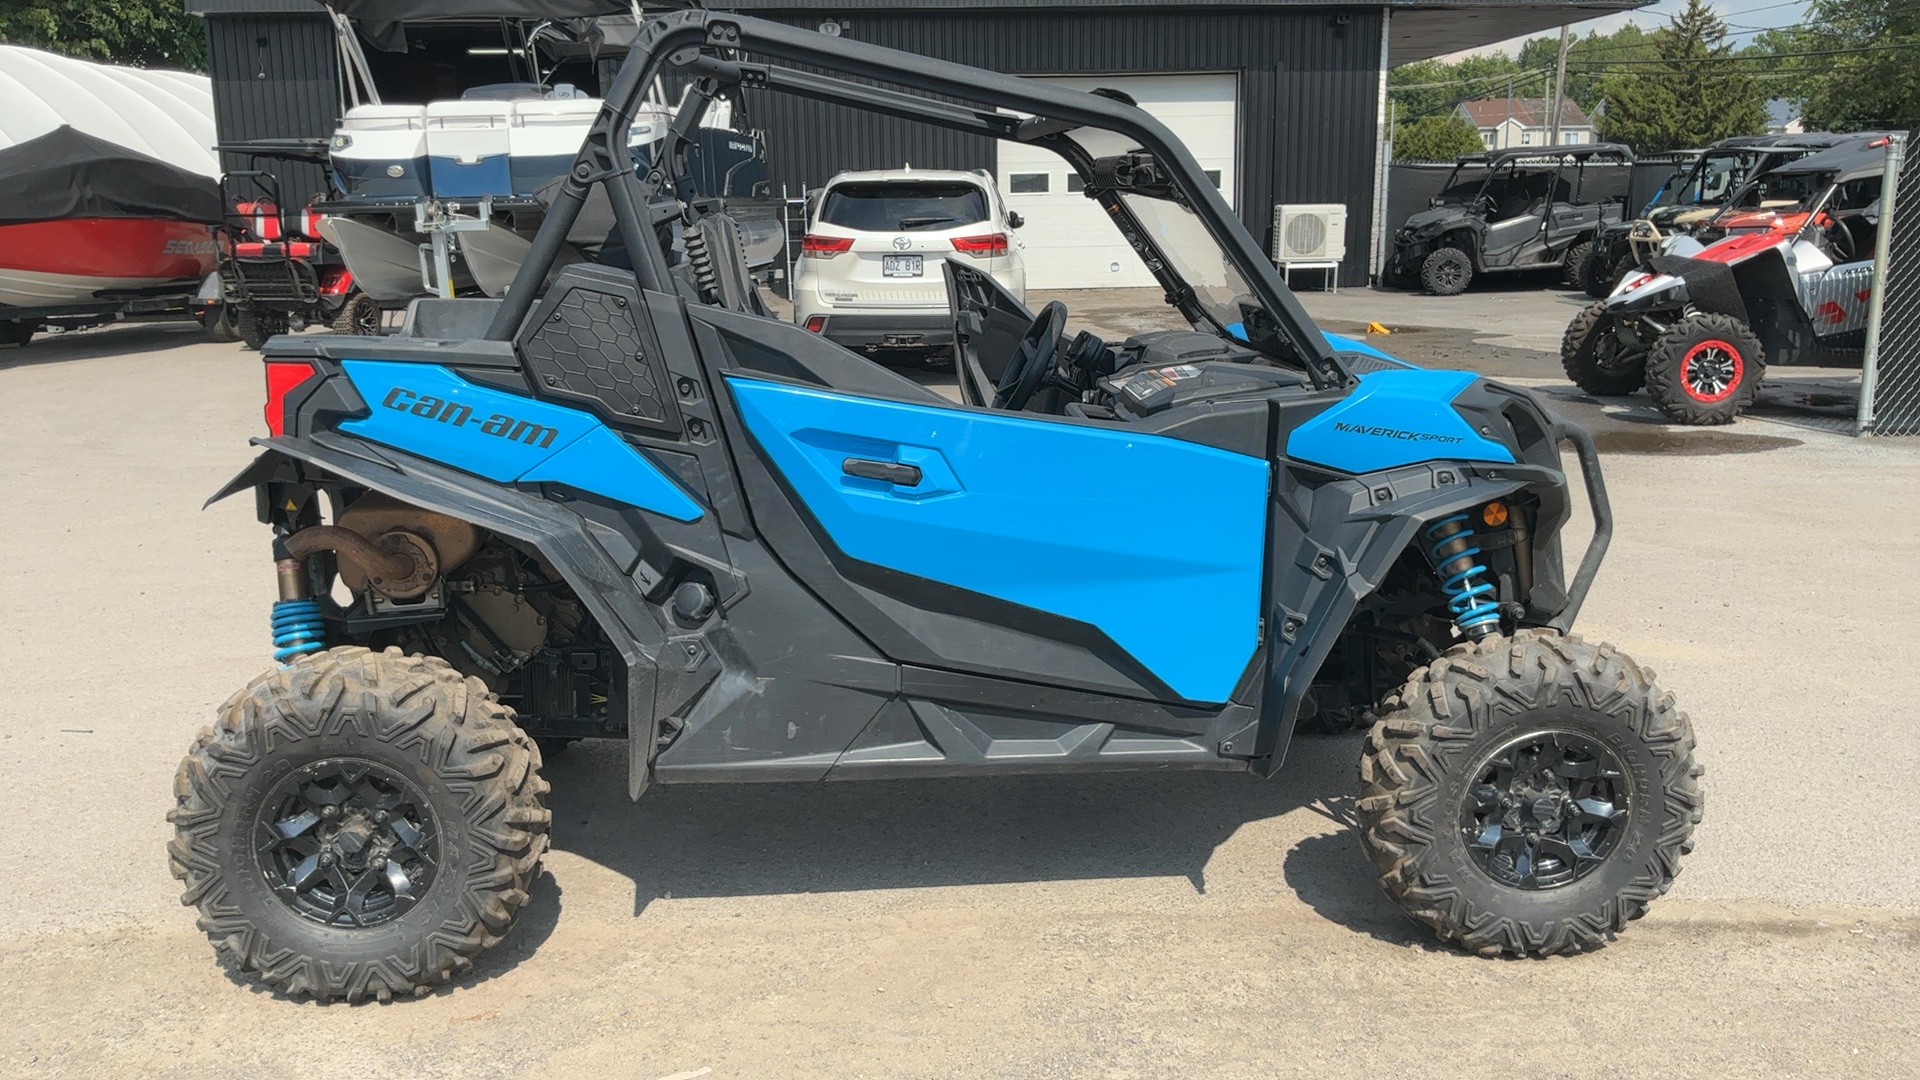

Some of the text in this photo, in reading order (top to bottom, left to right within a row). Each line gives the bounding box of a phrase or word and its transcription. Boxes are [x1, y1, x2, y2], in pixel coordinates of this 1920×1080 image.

[885, 260, 921, 271] ADZ 81R
[382, 387, 559, 449] can-am
[1334, 421, 1463, 444] MAVERICK SPORT
